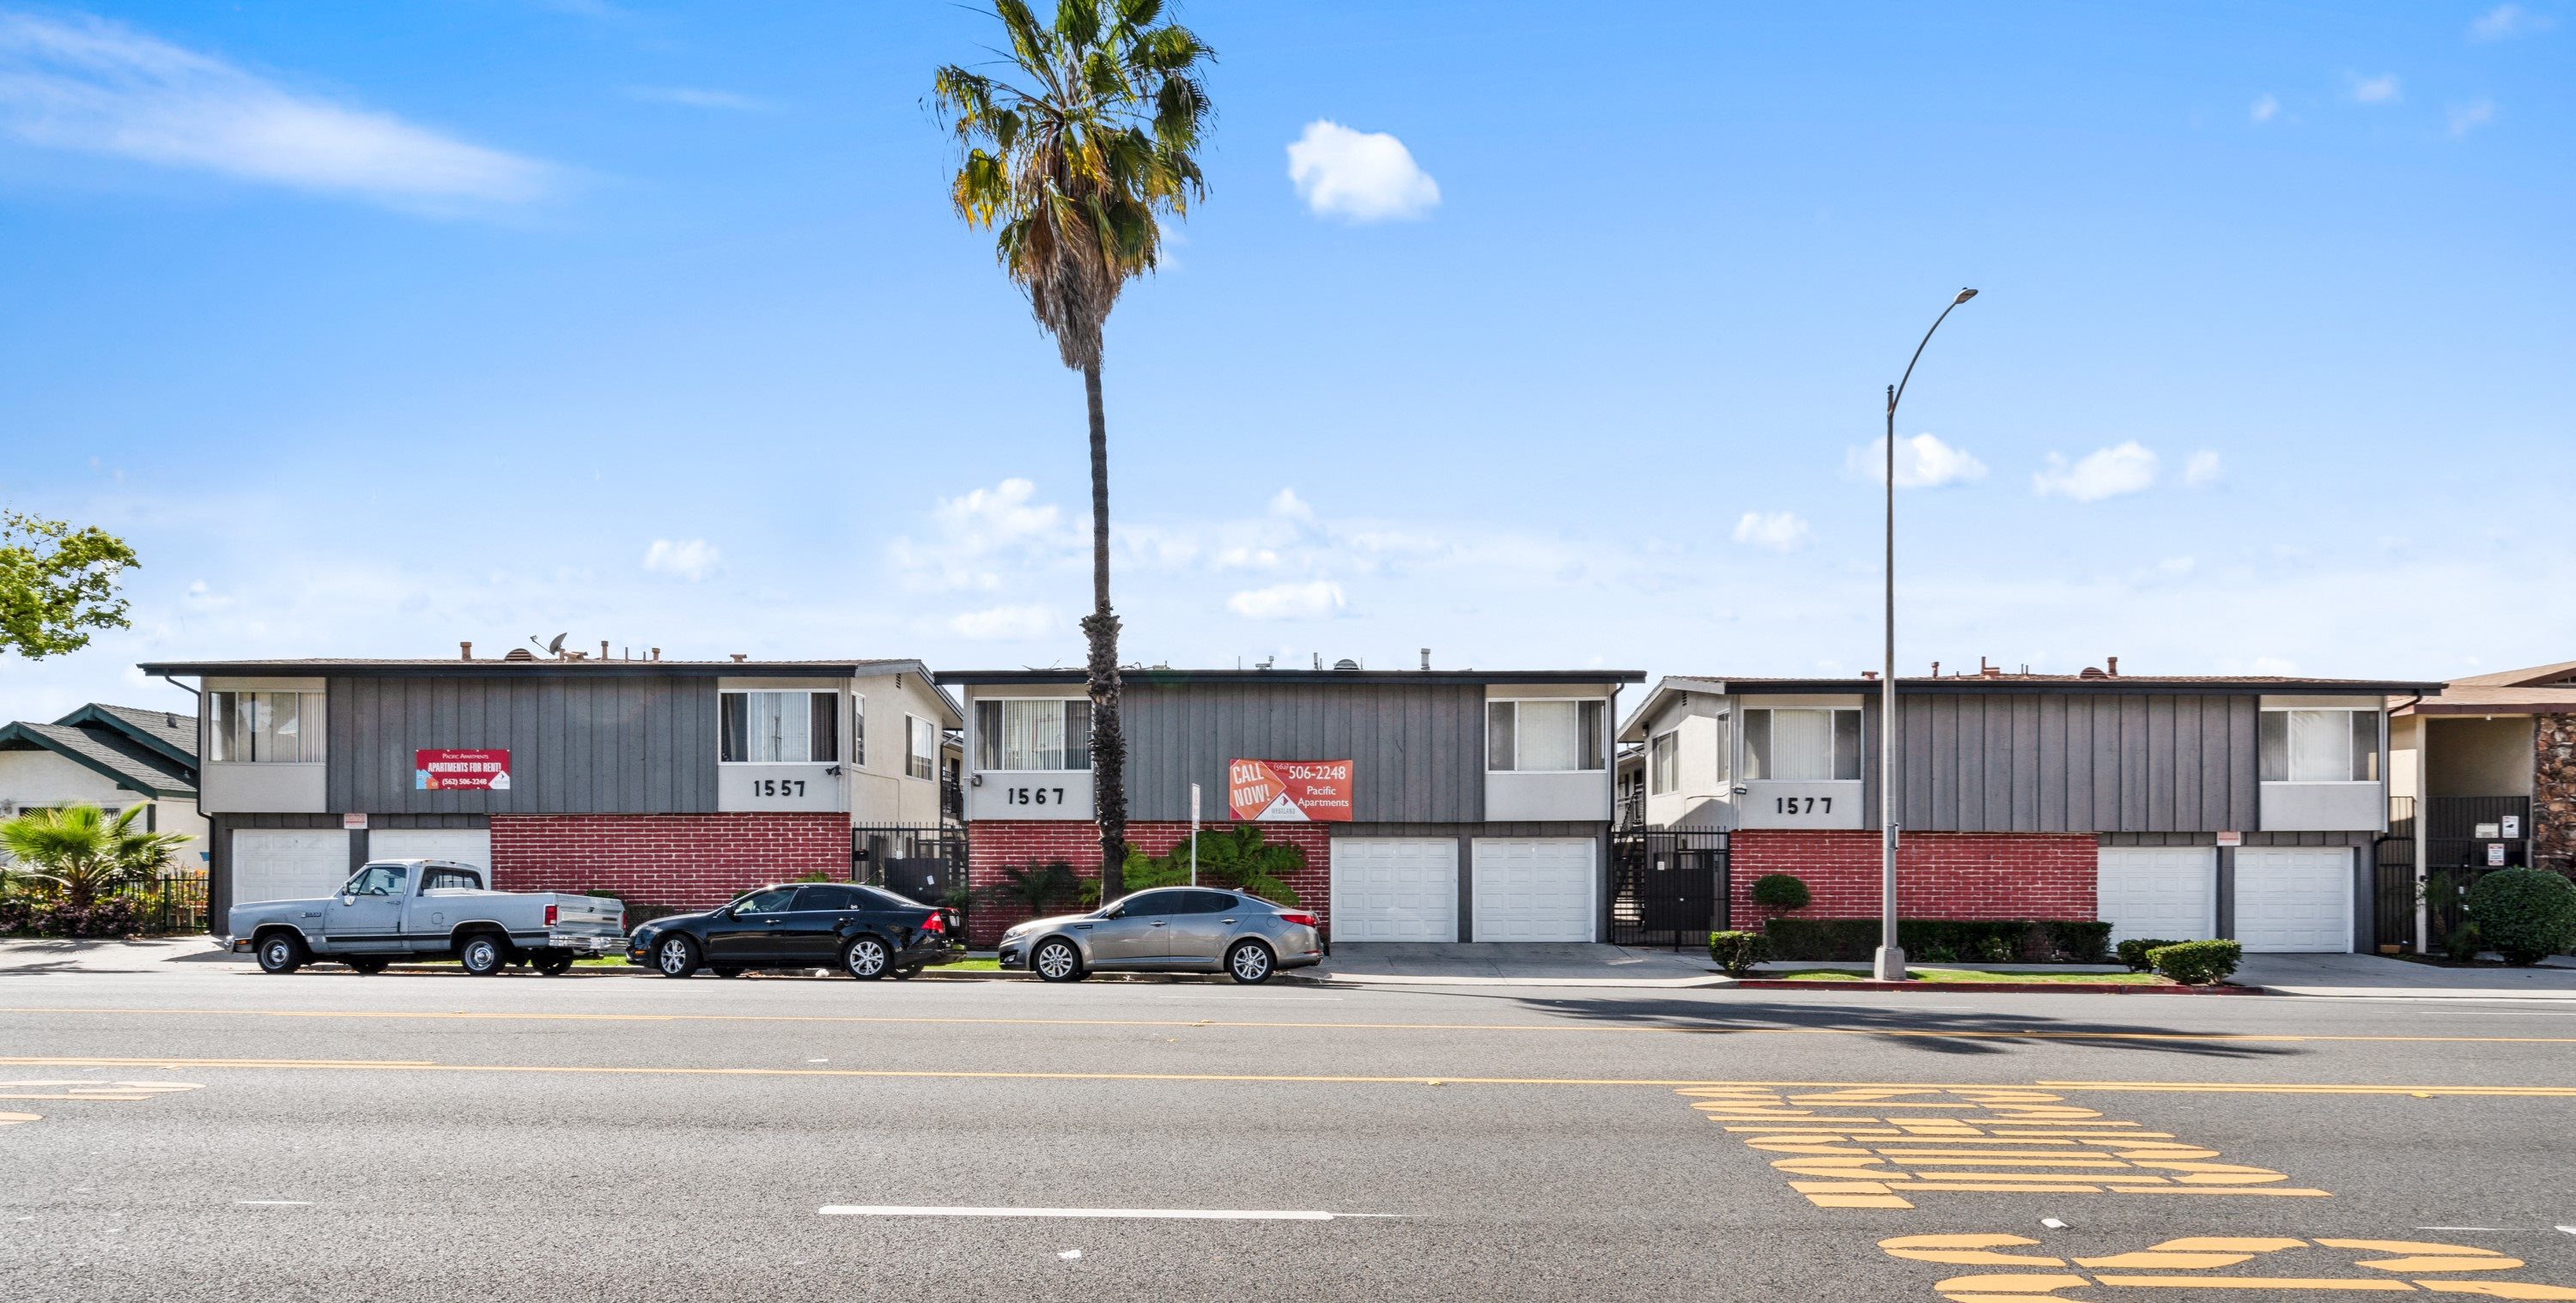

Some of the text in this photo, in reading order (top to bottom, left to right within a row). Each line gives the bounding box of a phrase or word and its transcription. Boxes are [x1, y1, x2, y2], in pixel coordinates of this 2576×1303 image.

[428, 762, 501, 773] APARTMENTS FOR RENT!
[1232, 762, 1264, 785] CALL
[1273, 762, 1346, 779] (562) 506-2248
[754, 779, 805, 797] 1557
[1008, 787, 1064, 805] 1567
[1233, 783, 1271, 808] NOW!
[1307, 785, 1337, 796] Pacific
[1297, 797, 1350, 809] Apartments
[1777, 797, 1832, 815] 1577
[1674, 1086, 2333, 1209] SCHOOL
